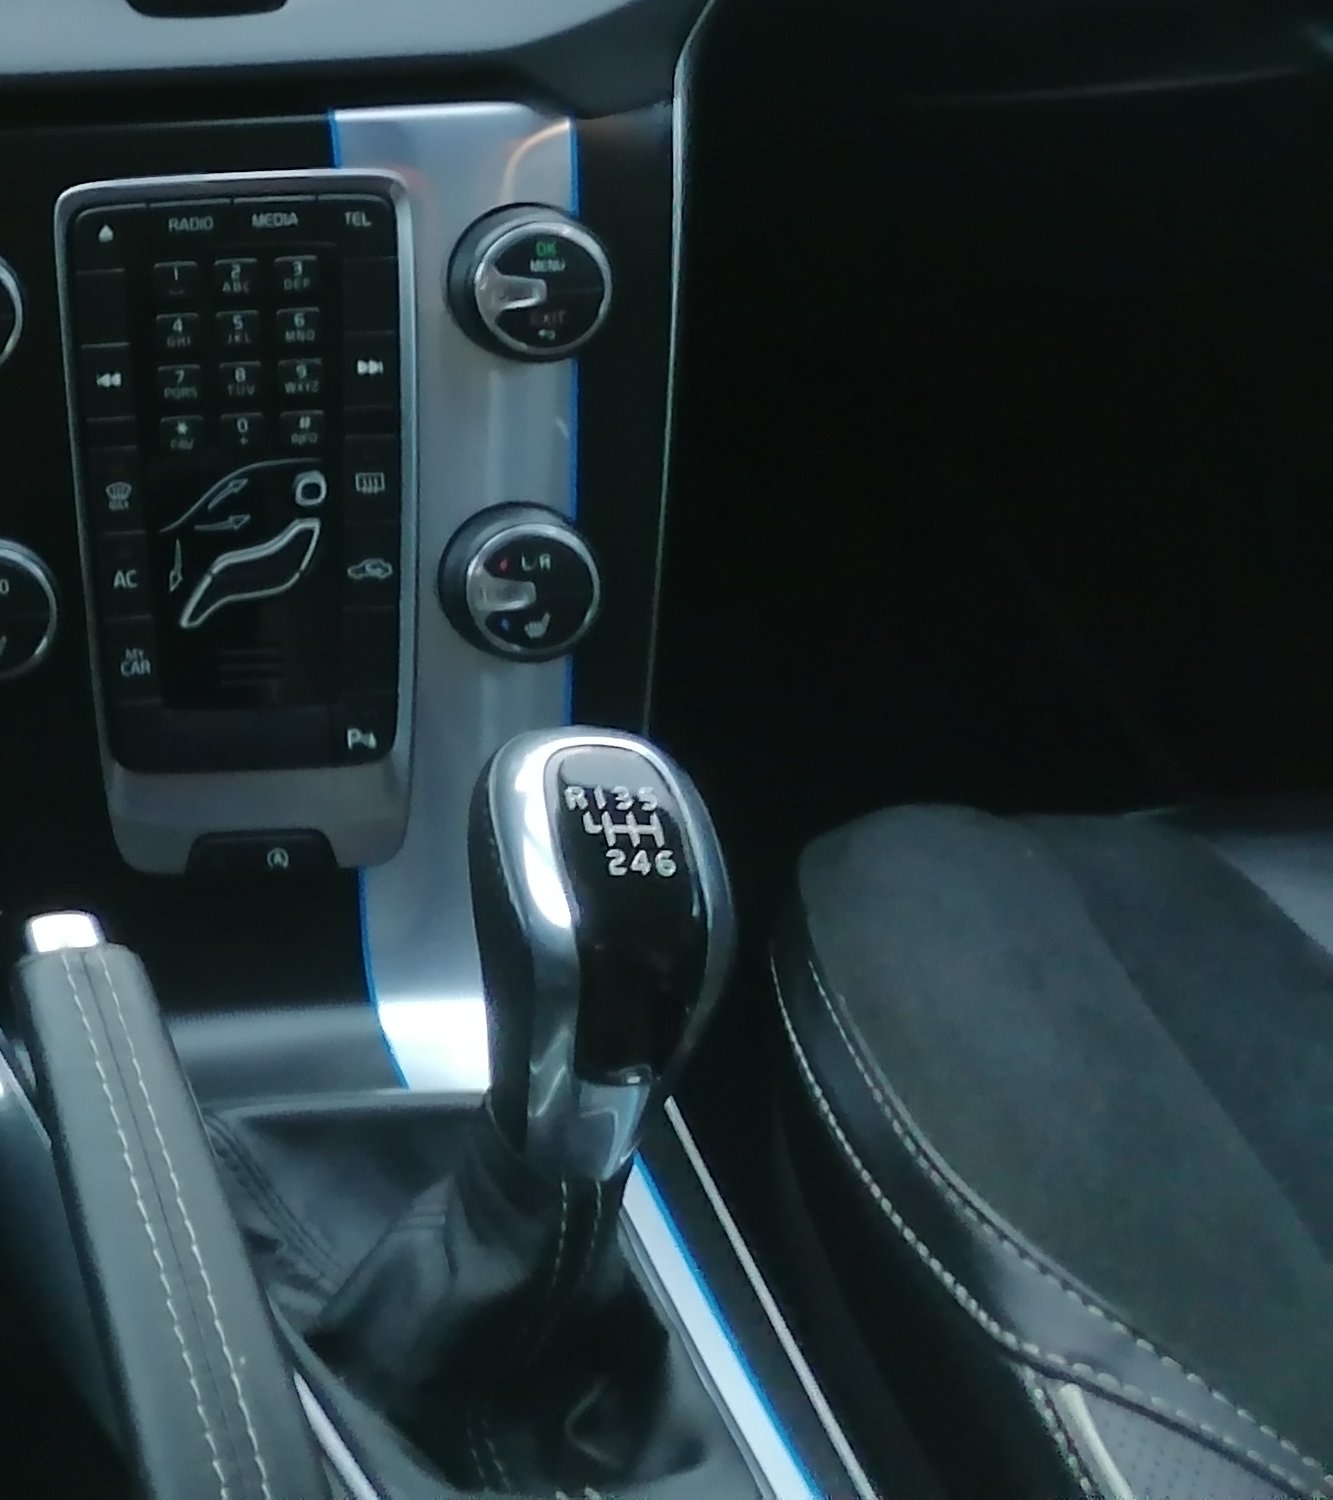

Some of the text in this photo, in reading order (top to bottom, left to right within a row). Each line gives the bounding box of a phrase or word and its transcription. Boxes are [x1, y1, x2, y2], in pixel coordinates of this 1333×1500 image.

[168, 210, 372, 233] RADIO MEDIA TEL
[535, 240, 558, 257] OK
[113, 569, 139, 589] AC
[125, 647, 145, 660] MY
[120, 660, 151, 677] CAR
